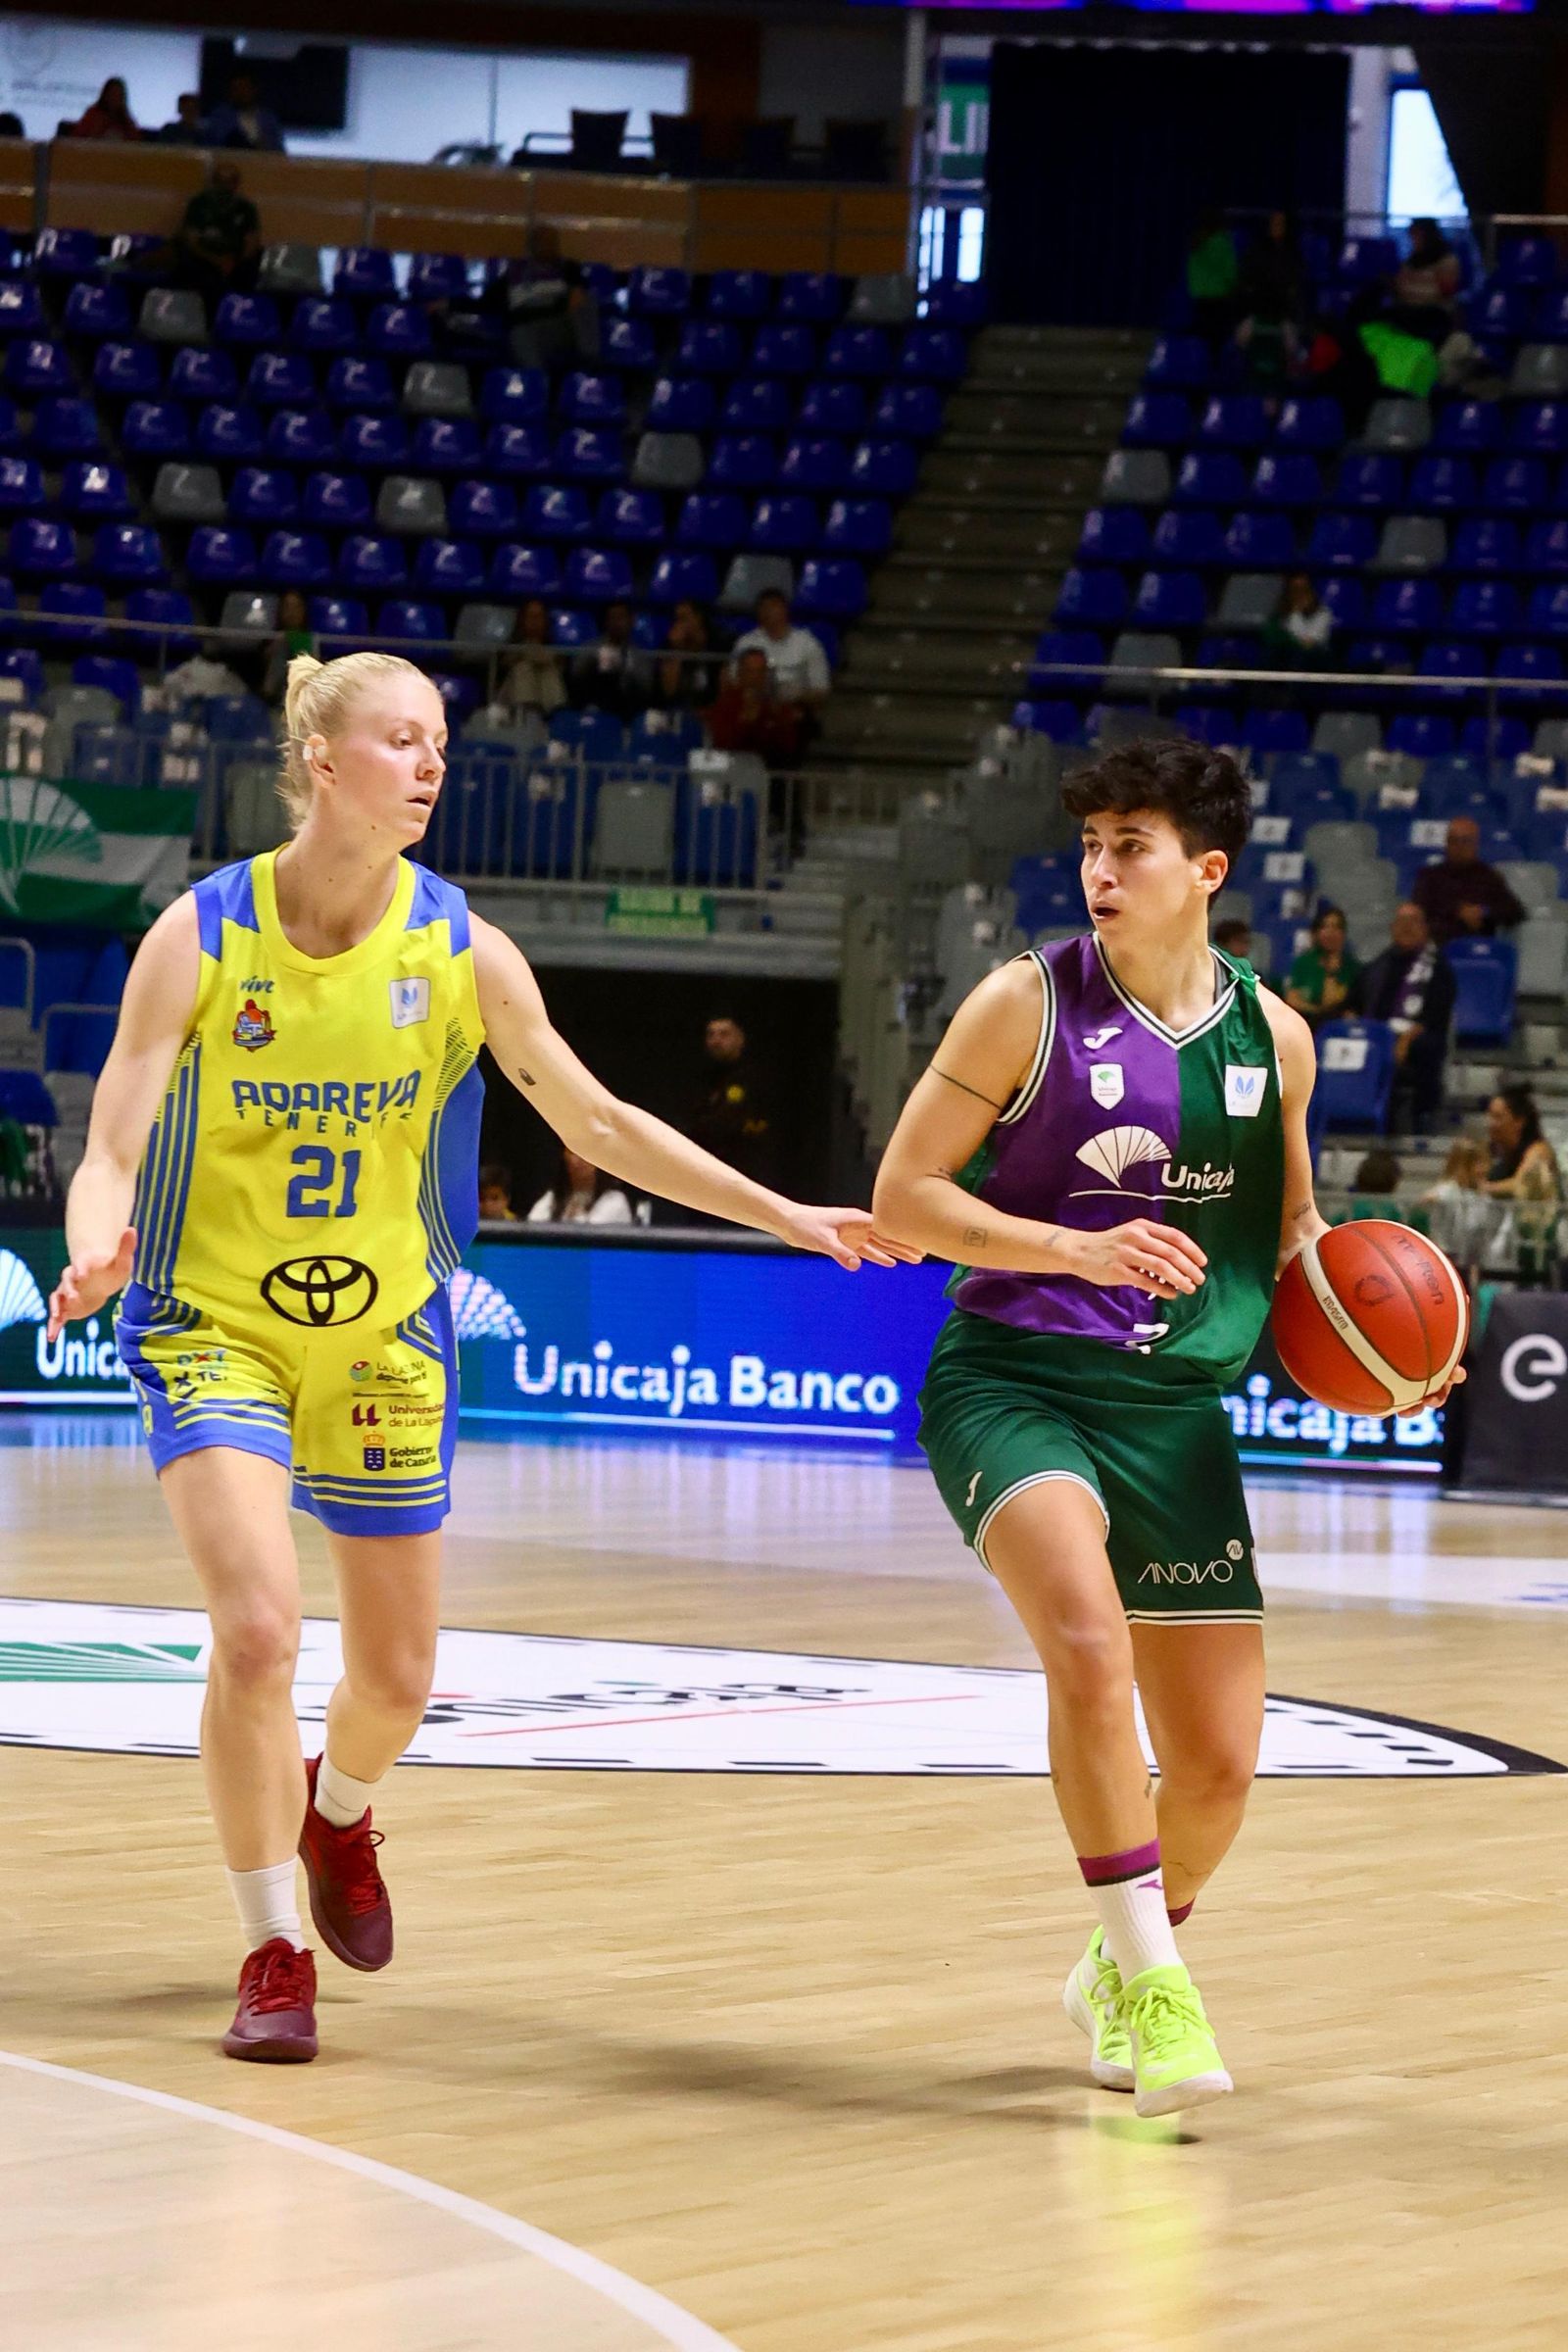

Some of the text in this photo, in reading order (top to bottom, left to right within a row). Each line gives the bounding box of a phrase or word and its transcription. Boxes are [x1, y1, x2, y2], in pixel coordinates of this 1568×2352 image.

[236, 1108, 412, 1137] TENERF
[286, 1145, 362, 1217] 21
[36, 1317, 135, 1388] Unica
[514, 1340, 900, 1417] Unicaja Banco
[1221, 1374, 1388, 1456] nicaja
[390, 1457, 404, 1468] de
